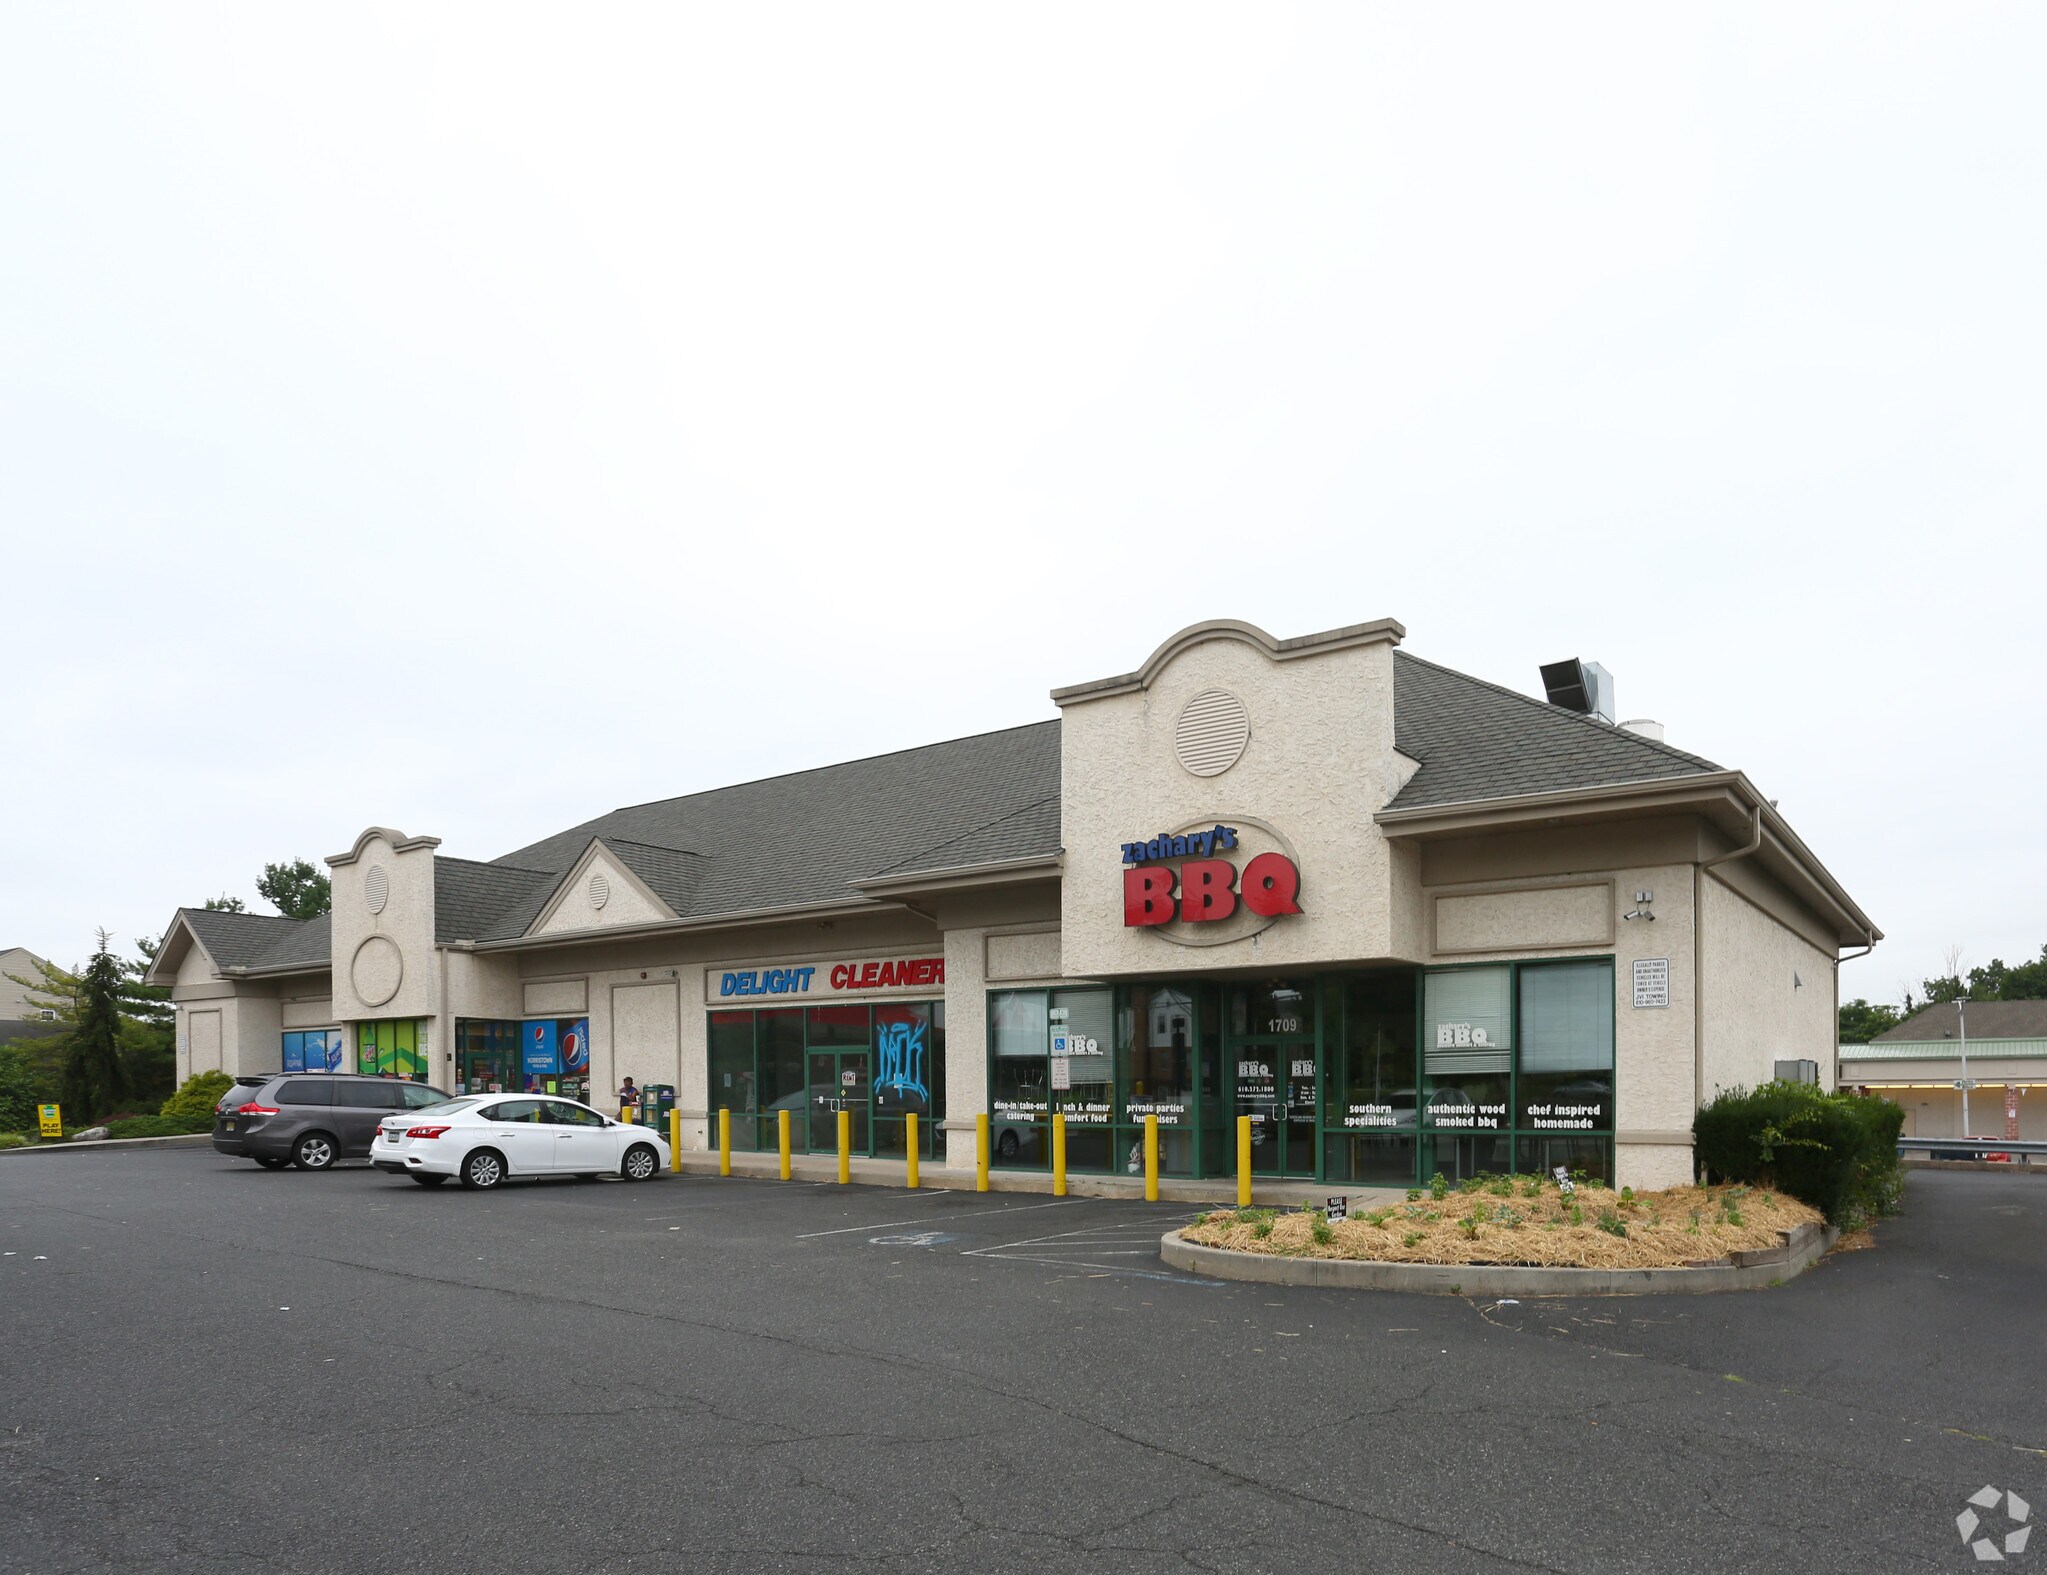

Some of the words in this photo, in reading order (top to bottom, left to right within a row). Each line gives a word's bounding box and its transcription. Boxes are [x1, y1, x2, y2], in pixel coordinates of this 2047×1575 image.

[1121, 824, 1238, 864] zachary's
[1124, 852, 1304, 927] BBQ
[720, 967, 815, 996] DELIGHT
[830, 958, 944, 990] CLEANER
[1269, 1019, 1297, 1032] 1709
[1438, 1028, 1487, 1044] BBQ
[1239, 1064, 1269, 1077] BBQ
[1292, 1063, 1315, 1076] BB
[994, 1101, 1047, 1110] dine-in/take-out
[1056, 1102, 1076, 1112] lnch
[1078, 1103, 1084, 1112] &
[1086, 1102, 1110, 1112] dinner
[1126, 1103, 1154, 1114] private
[1156, 1103, 1184, 1114] parties
[1349, 1104, 1392, 1113] southern
[1427, 1104, 1476, 1114] authentic
[1479, 1104, 1505, 1114] wood
[1527, 1104, 1551, 1115] chef
[1555, 1104, 1600, 1117] inspired
[1007, 1111, 1034, 1121] catering
[1064, 1113, 1088, 1122] omfort
[1091, 1113, 1107, 1123] food
[1344, 1116, 1397, 1127] specialities
[1435, 1117, 1474, 1127] smoked
[1478, 1117, 1497, 1129] bbq
[1534, 1118, 1593, 1129] homemade
